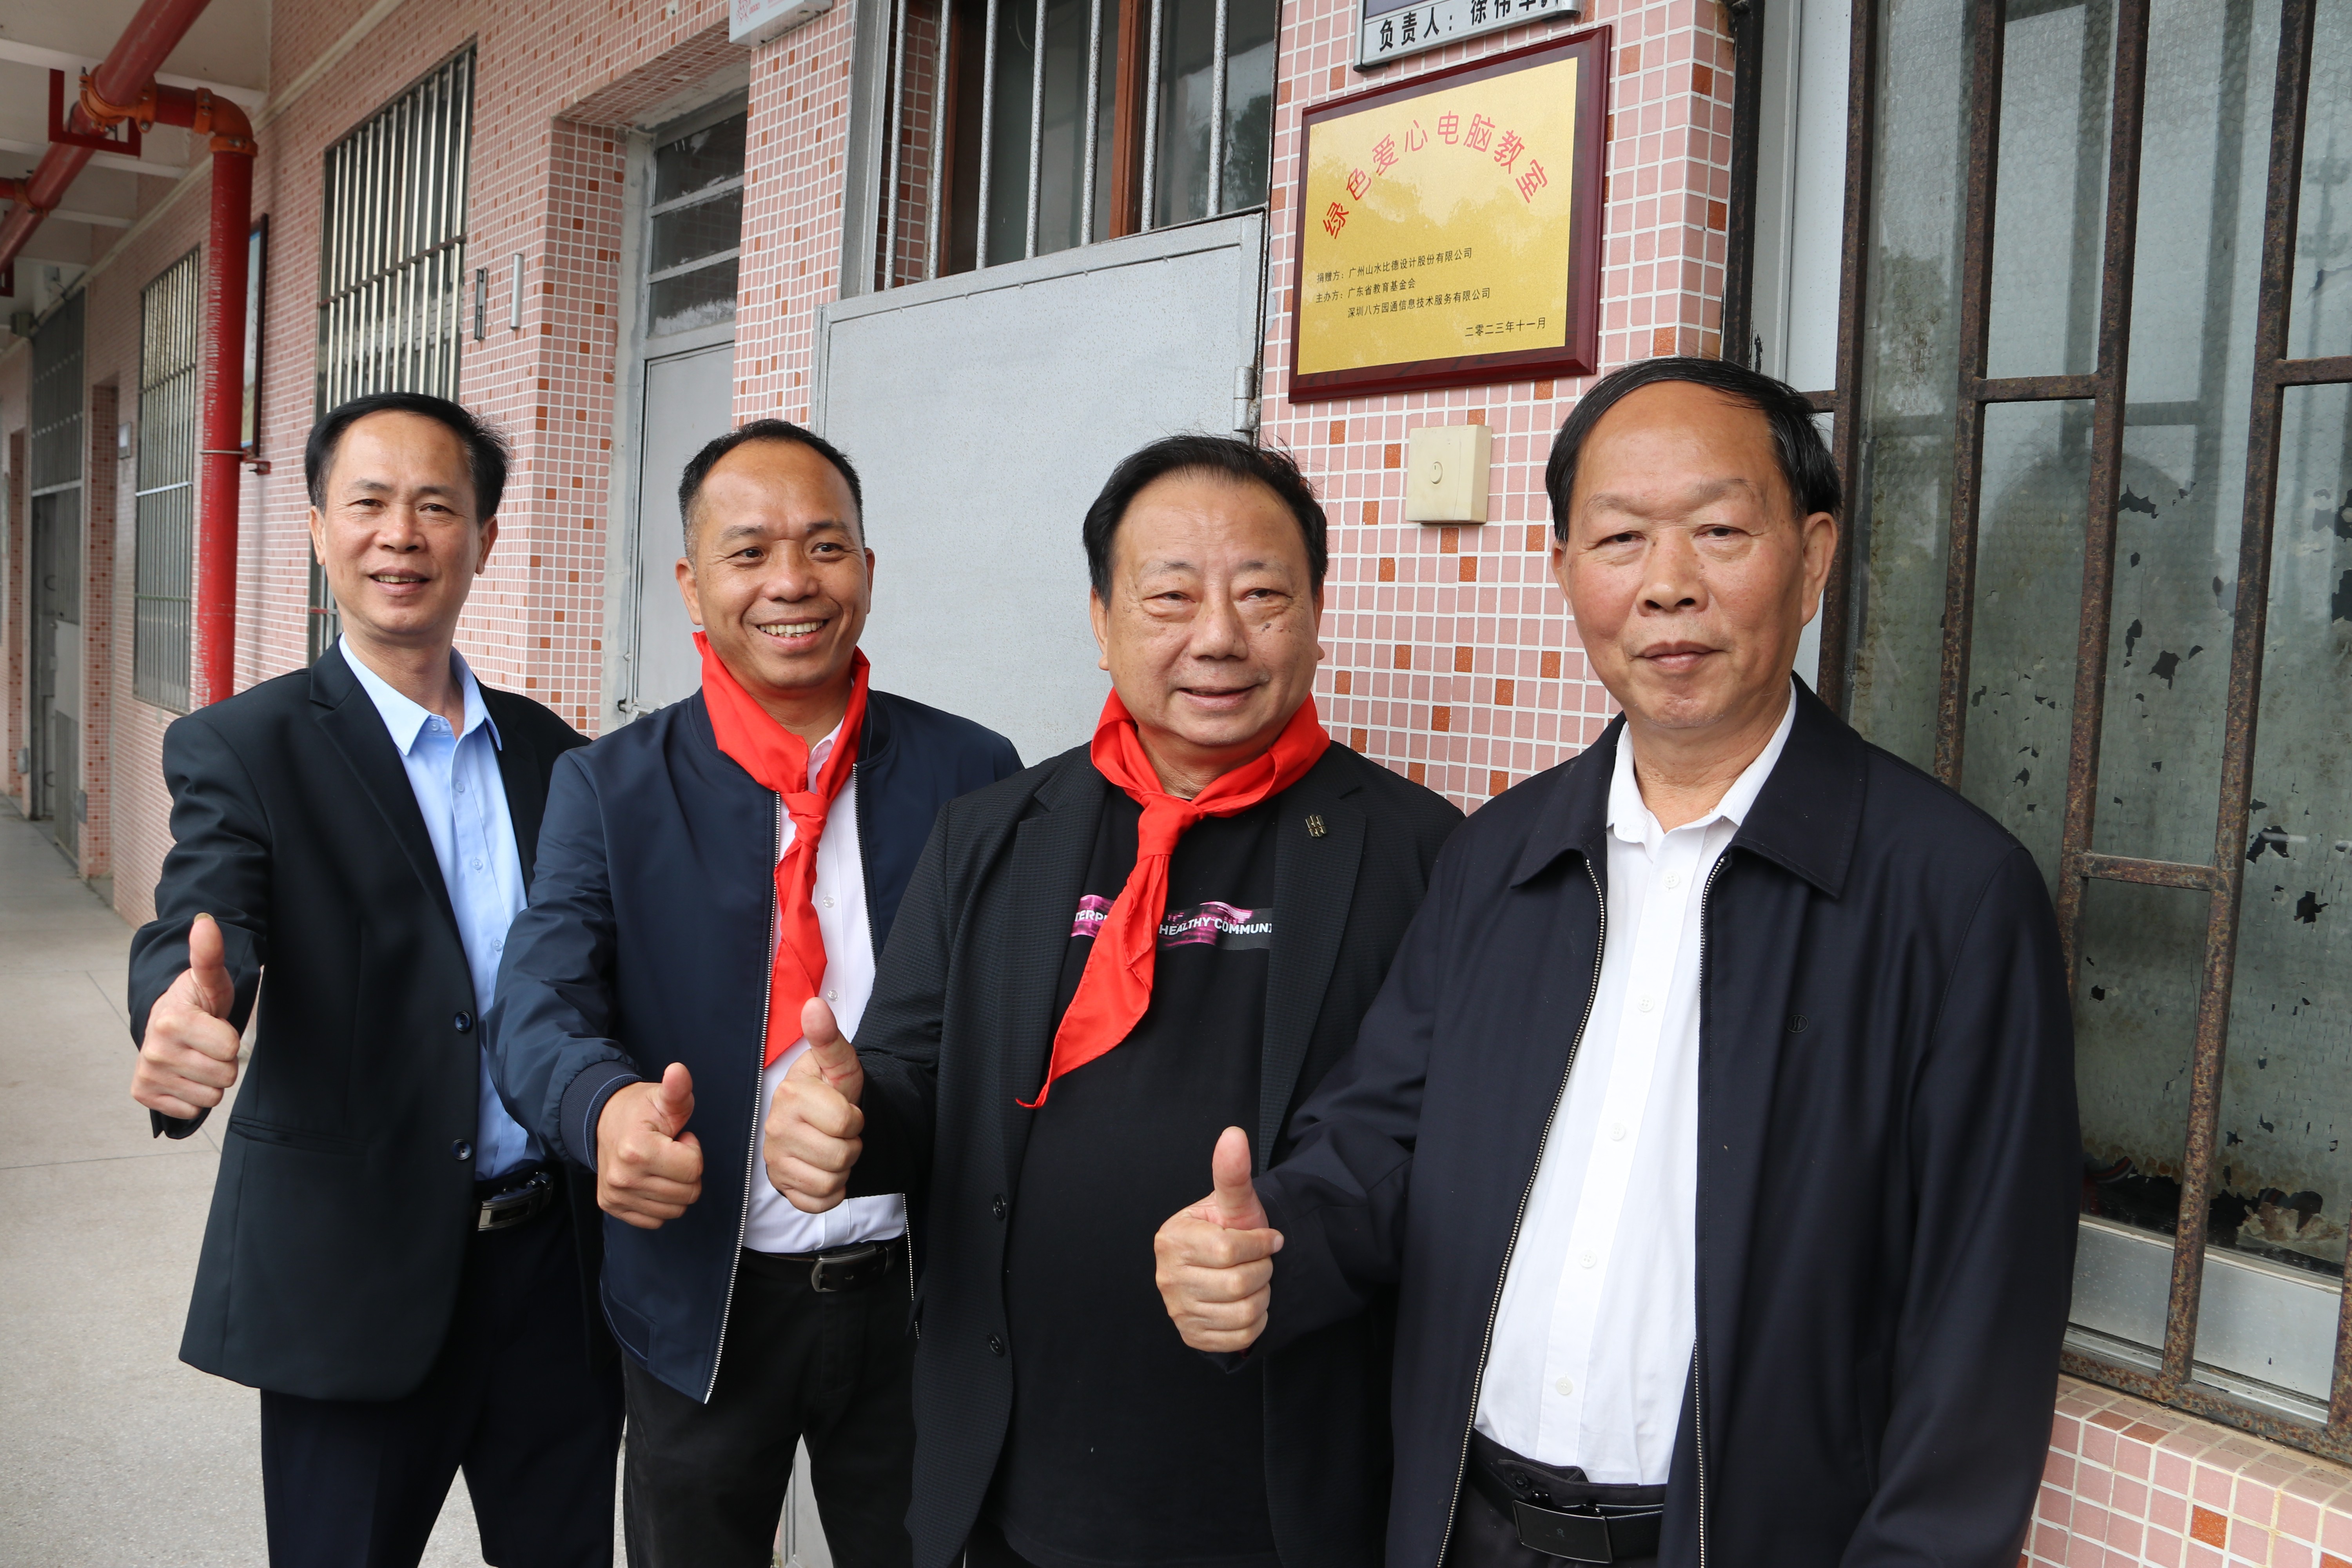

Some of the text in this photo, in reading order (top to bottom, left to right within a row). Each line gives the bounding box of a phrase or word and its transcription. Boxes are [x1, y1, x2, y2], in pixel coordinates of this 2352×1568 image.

[1323, 110, 1548, 240] 绿色爱心电脑教室
[1317, 247, 1472, 284] 捐赠方：广州山水比德设计股份有限公司
[1316, 278, 1416, 303] 主办方：广东省教育基金会
[1348, 287, 1491, 318] 深圳八方园通信息技术服务有限公司
[1465, 317, 1546, 337] 二零二三年十一月
[1159, 917, 1211, 936] HEALTHY
